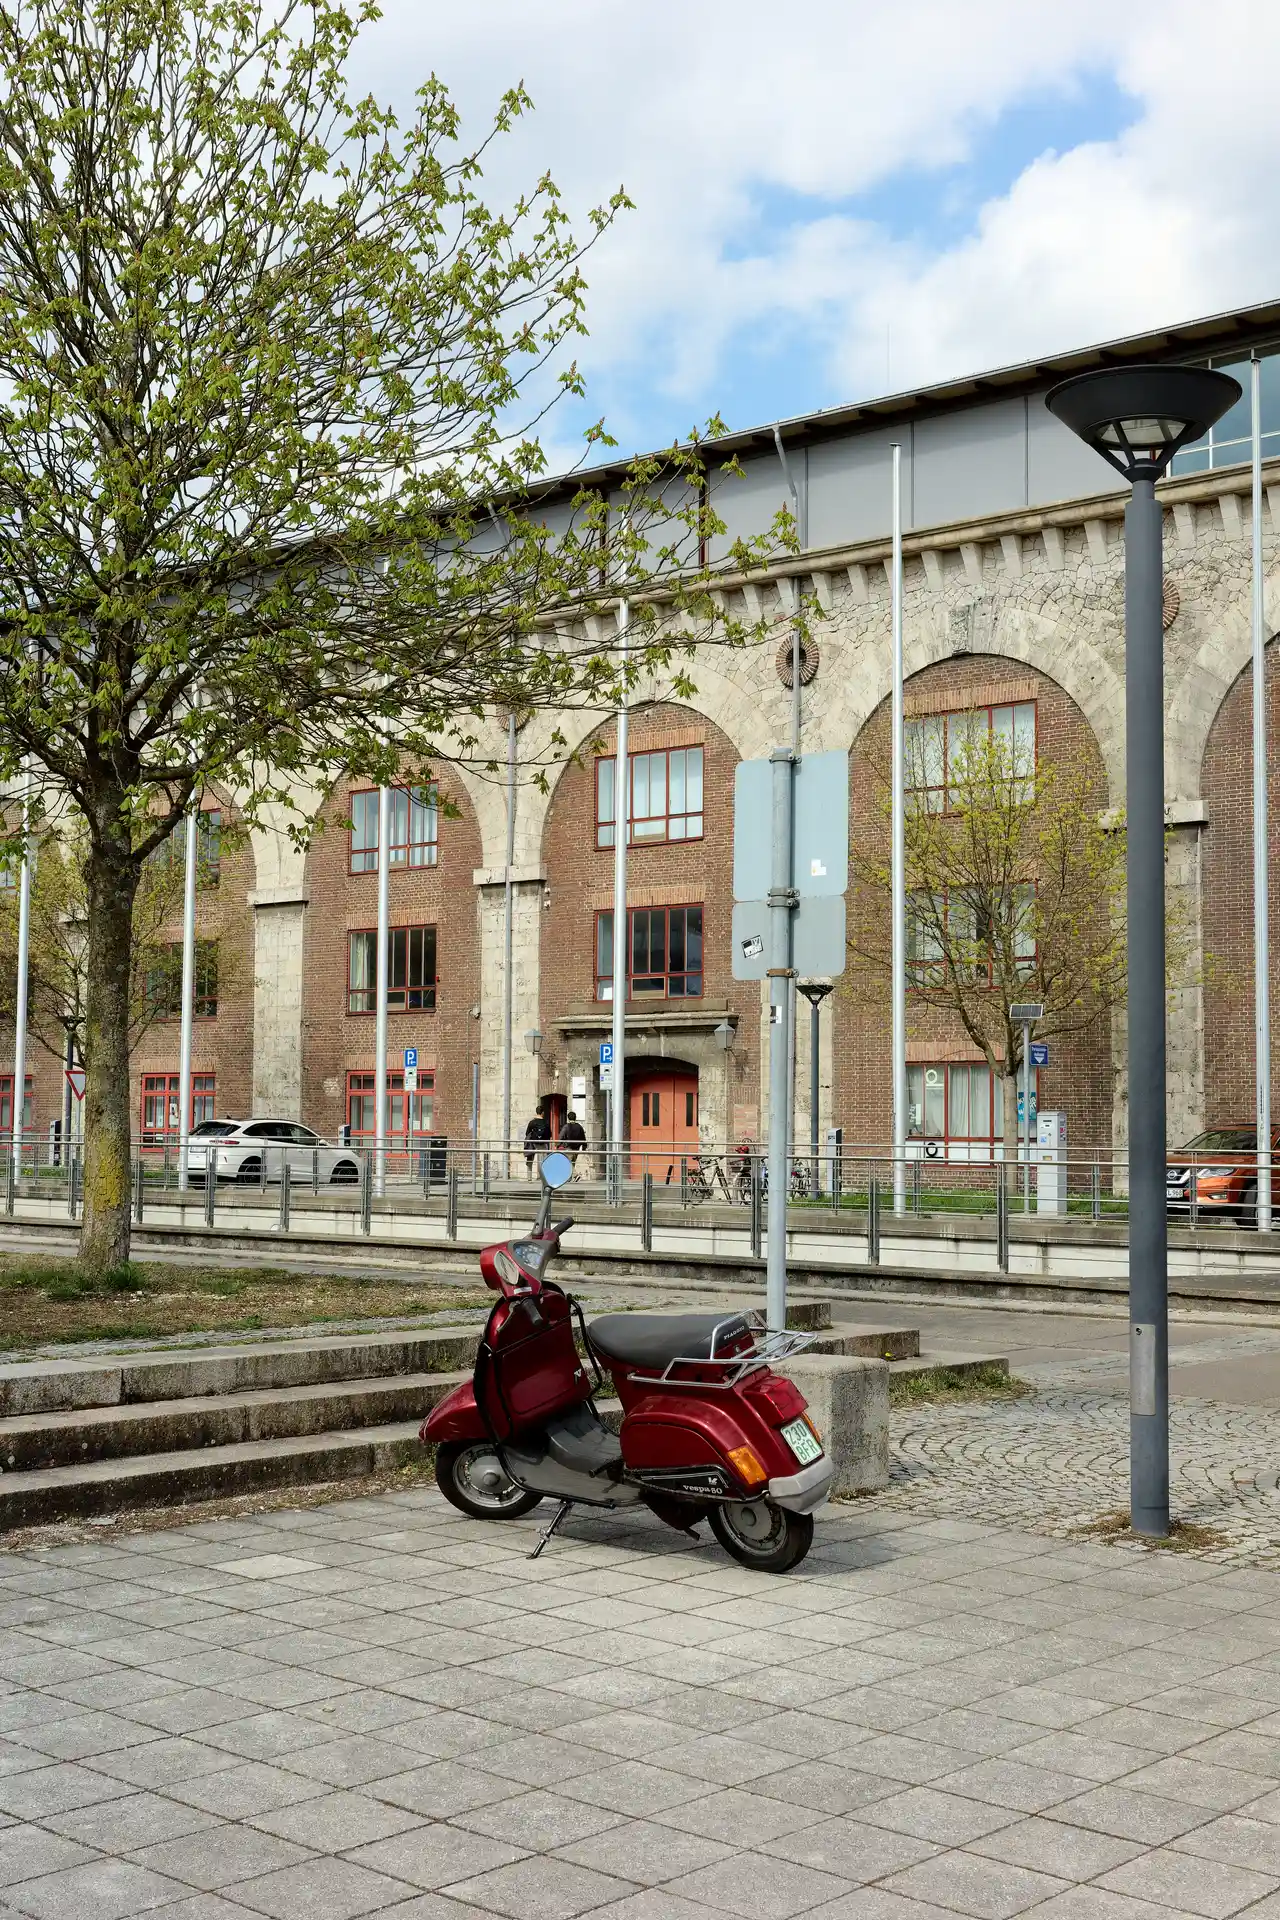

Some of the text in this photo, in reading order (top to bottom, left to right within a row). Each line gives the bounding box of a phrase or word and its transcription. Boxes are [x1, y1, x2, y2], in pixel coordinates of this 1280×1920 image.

[407, 1051, 414, 1065] P
[603, 1046, 611, 1061] P
[785, 1422, 807, 1445] 230
[795, 1439, 818, 1461] BFR
